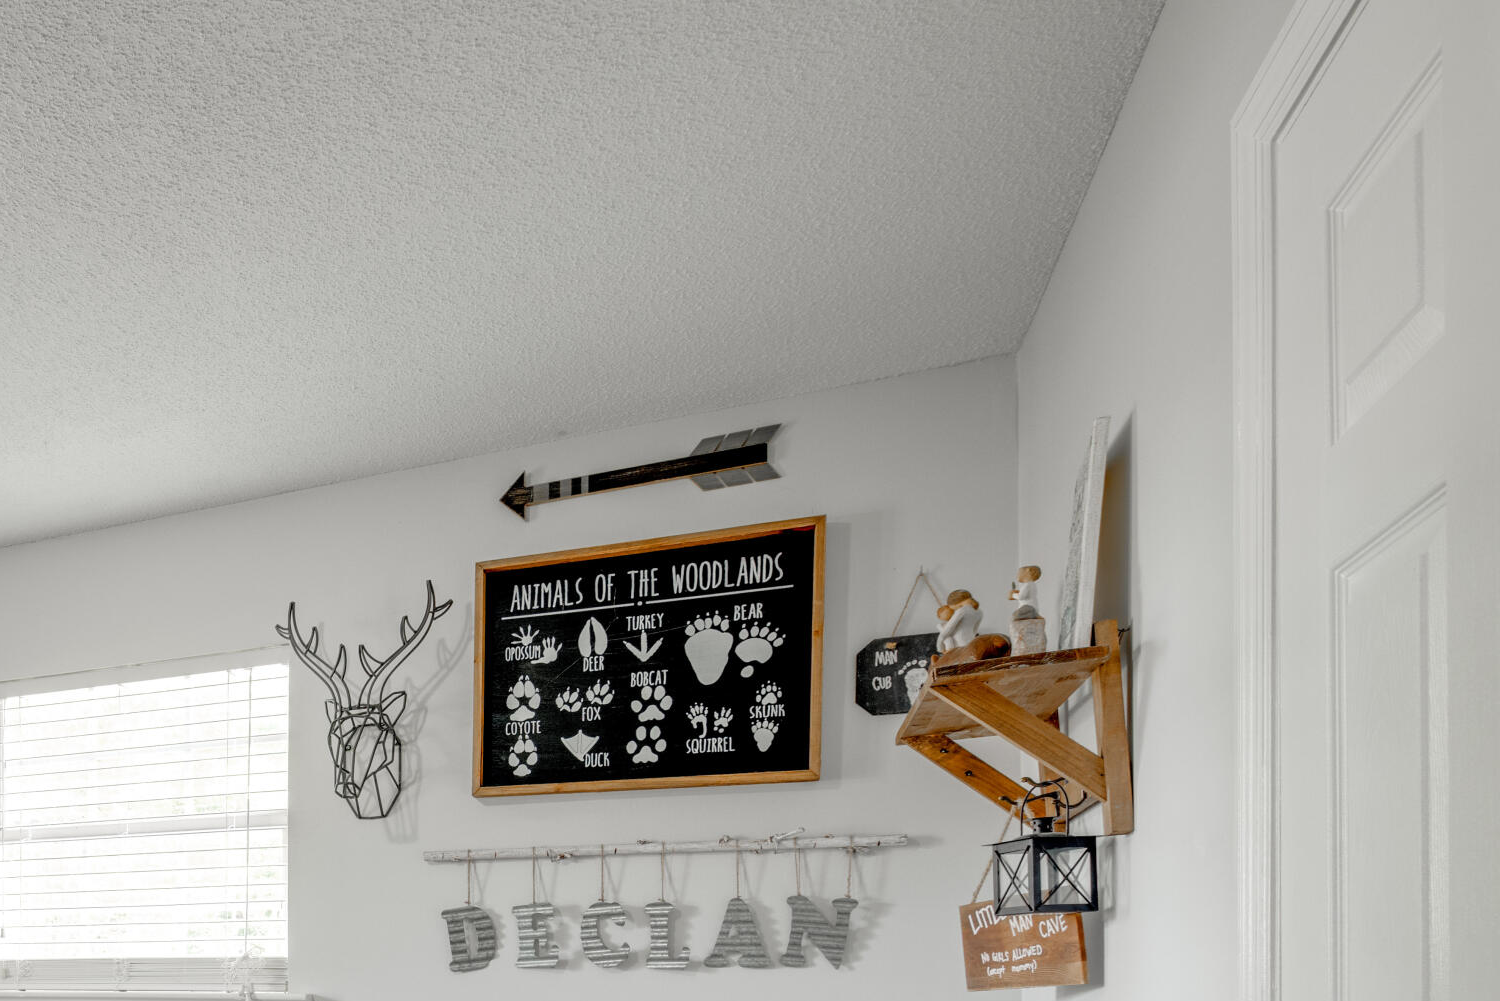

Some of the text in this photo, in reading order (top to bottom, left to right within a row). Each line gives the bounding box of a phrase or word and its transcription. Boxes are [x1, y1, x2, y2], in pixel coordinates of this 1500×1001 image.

[510, 552, 784, 612] ANIMALS OF THE WOODLANDS
[734, 603, 762, 621] BEAR
[626, 613, 663, 631] TURKEY
[505, 646, 540, 662] OPOSSUM
[875, 650, 898, 667] MAN
[583, 656, 604, 672] DEER
[631, 670, 668, 687] BOBCAT
[872, 676, 892, 691] CUB
[582, 707, 600, 721] FOX
[750, 704, 785, 719] SKUNK
[506, 721, 541, 735] COYOTE
[686, 737, 735, 753] SQUIRREL
[584, 752, 609, 767] DUCK
[968, 904, 1068, 938] LITTL MAN CAVE
[441, 895, 858, 972] DECLAN
[1012, 944, 1042, 960] ALLOWED
